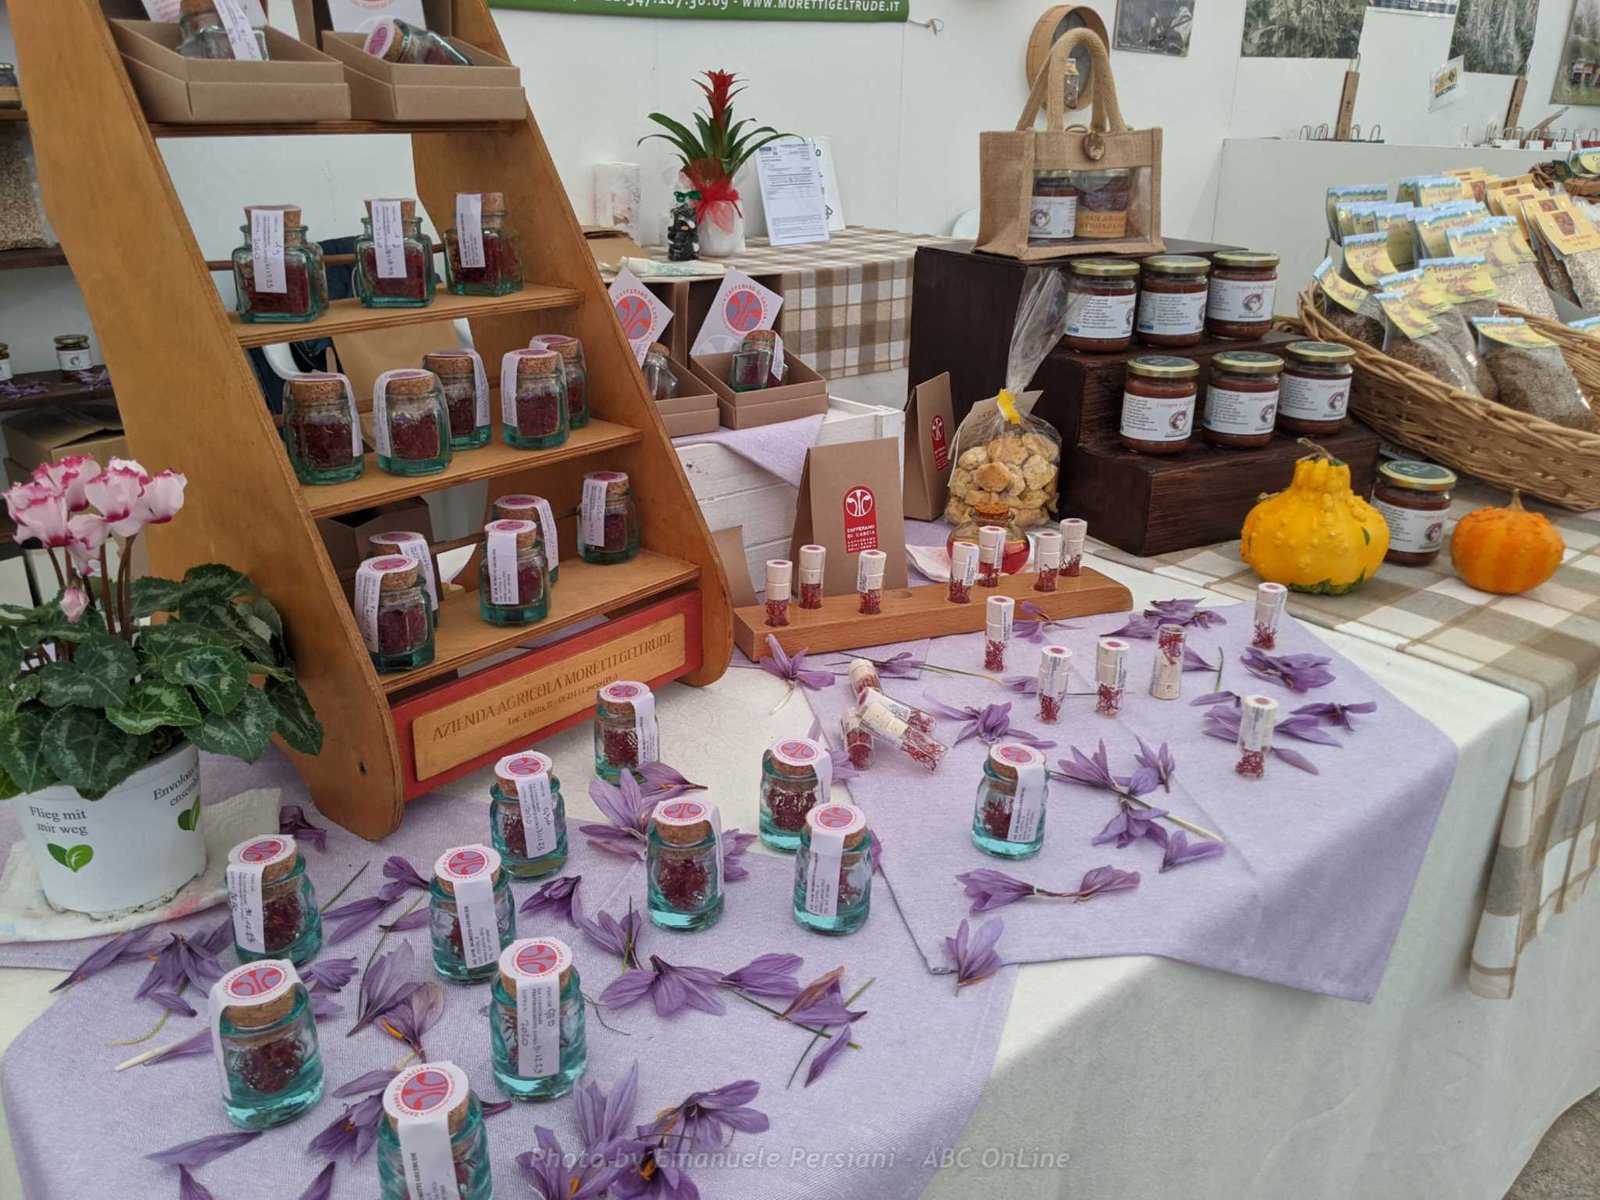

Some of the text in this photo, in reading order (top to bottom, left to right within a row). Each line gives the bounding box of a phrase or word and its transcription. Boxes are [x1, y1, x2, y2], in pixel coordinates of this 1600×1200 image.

[847, 525, 875, 534] ZAFFERANO
[856, 530, 875, 538] CASCIA
[433, 632, 675, 742] AZIENDA AGRICOLA MORETTI GELTRUDE
[29, 806, 87, 822] Flieg mit
[37, 823, 88, 837] mir weg
